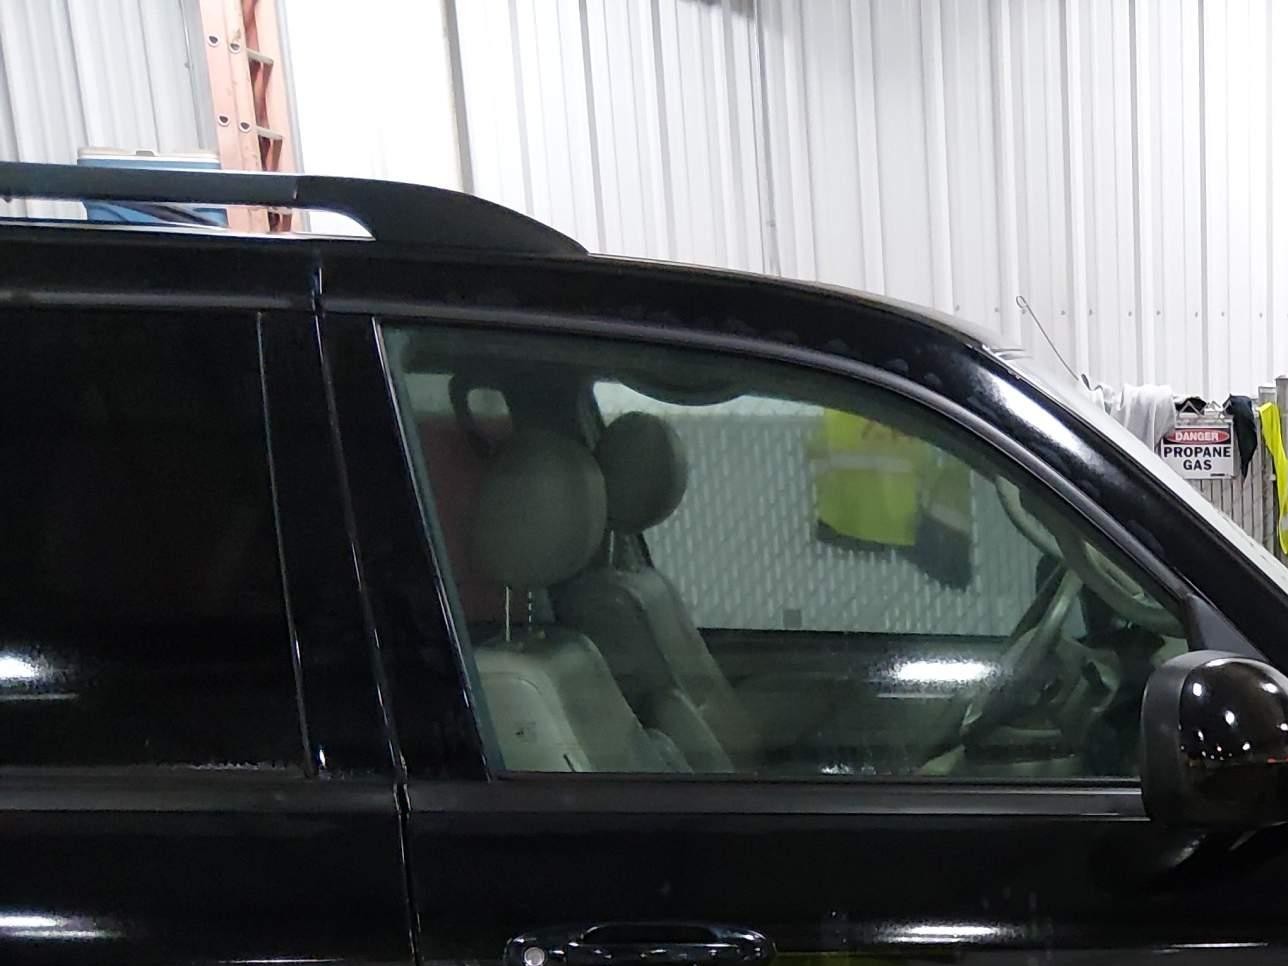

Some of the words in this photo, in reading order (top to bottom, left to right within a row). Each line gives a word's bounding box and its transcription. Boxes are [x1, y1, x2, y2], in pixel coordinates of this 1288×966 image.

[1175, 432, 1219, 441] DANGER
[1164, 447, 1231, 457] PROPANE
[1183, 460, 1212, 470] GAS
